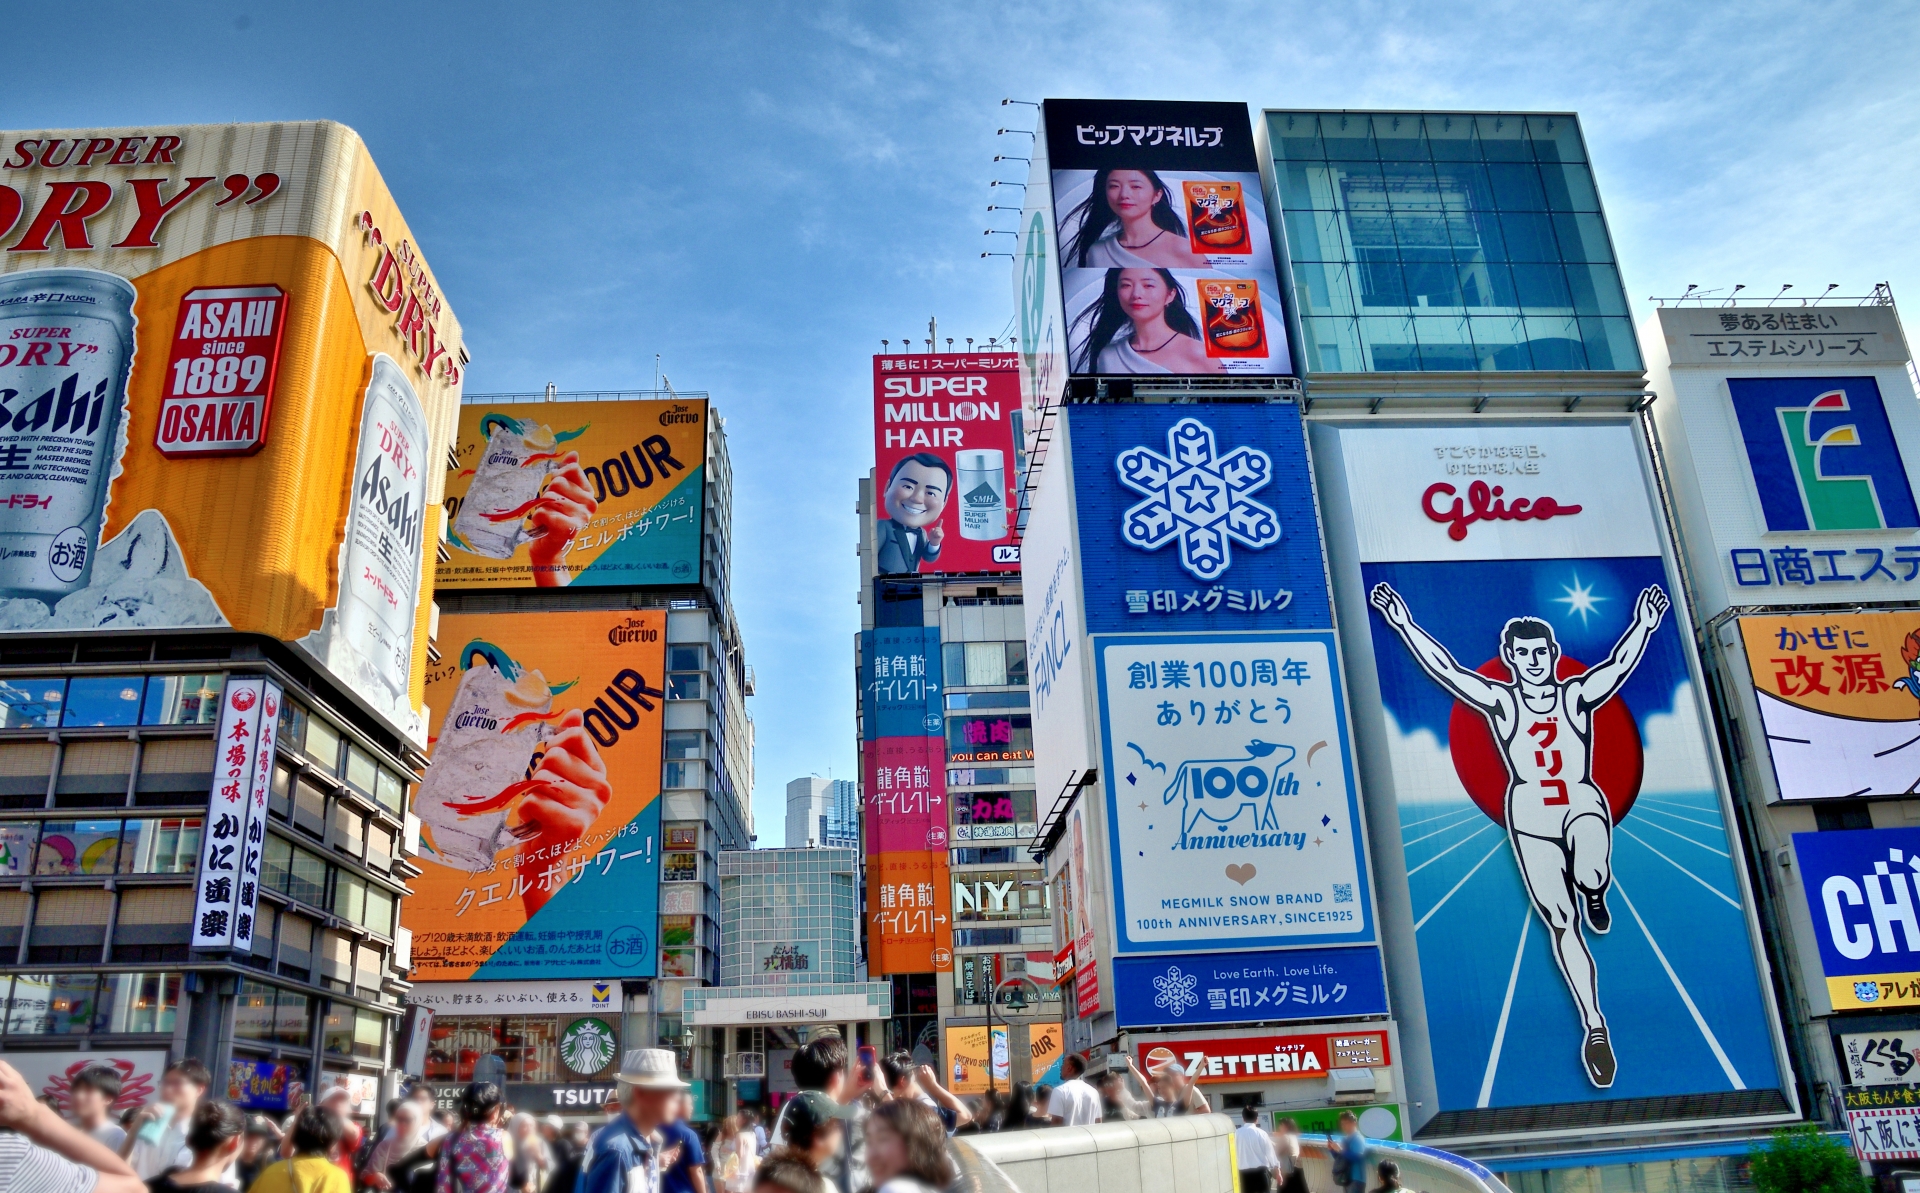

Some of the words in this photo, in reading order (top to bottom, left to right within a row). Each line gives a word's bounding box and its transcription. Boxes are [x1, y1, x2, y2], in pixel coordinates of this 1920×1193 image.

[1076, 125, 1224, 147] ピップマグネループ
[3, 135, 182, 170] SUPER
[0, 173, 281, 252] RY”
[1197, 198, 1233, 207] マグネループ
[401, 238, 442, 321] SUPER
[65, 294, 96, 303] KUCHI
[1211, 298, 1249, 307] マグネループ
[178, 300, 276, 341] ASAHI
[1718, 313, 1838, 331] 夢ある住まい
[9, 327, 72, 340] SUPER
[201, 340, 246, 355] since
[1706, 337, 1868, 357] エステムシリーズ
[171, 355, 268, 396] 1889
[884, 376, 988, 398] SUPER
[658, 410, 699, 426] Cuervo
[672, 404, 689, 414] Jose
[884, 401, 1000, 423] MILLION
[161, 402, 256, 443] OSAKA
[40, 435, 73, 444] PRECISION
[389, 420, 410, 453] SUPER
[885, 427, 964, 449] HAIR
[34, 454, 64, 462] MASTER
[36, 444, 61, 453] UNDER
[62, 446, 74, 454] THE
[488, 453, 518, 466] Cuervo
[48, 464, 89, 475] TECHNIQUES
[1446, 460, 1540, 476] ゆたかな人生
[360, 453, 418, 556] Asahi
[972, 494, 994, 503] SMH
[568, 496, 686, 535] ソーダで割って、ほどよくハジける
[51, 541, 87, 570] お酒
[378, 531, 393, 565] 生
[364, 566, 398, 610] スーパードライ
[1125, 585, 1293, 613] 雪印メグミルク
[625, 617, 645, 628] Jose
[608, 624, 657, 646] Cuervo
[1774, 624, 1869, 651] かぜに
[874, 654, 928, 679] 龍角散
[1035, 600, 1071, 720] FANCL
[1127, 657, 1311, 690] 創業100周年
[1770, 652, 1890, 697] 改源
[455, 710, 497, 730] Cuervo
[472, 704, 490, 715] Jose
[583, 668, 664, 752] OUR
[1156, 697, 1292, 726] ありがとう
[923, 718, 941, 727] 生薬
[962, 719, 1013, 744] 焼肉
[220, 718, 250, 803] 本場の味
[254, 723, 273, 809] 本場の味
[951, 750, 973, 762] you
[976, 750, 999, 761] can
[1002, 749, 1022, 761] eat
[1526, 716, 1570, 806] グリコ
[877, 765, 931, 790] 龍角散
[972, 797, 1014, 819] 力丸
[928, 831, 945, 840] 生薬
[1171, 830, 1306, 850] Anniversary
[467, 821, 639, 880] ソーダで割って、ほどよくハジける
[880, 883, 935, 908] 龍角散
[1161, 896, 1224, 910] MEGMILK
[1230, 894, 1270, 907] SNOW
[1276, 893, 1323, 905] BRAND
[1136, 917, 1173, 930] 100th
[609, 937, 643, 955] お酒
[772, 945, 799, 955] なんば
[763, 954, 809, 971] 戎橋筋
[933, 953, 949, 962] 生薬
[964, 961, 975, 999] 焼きそば
[1213, 969, 1240, 980] Love
[1243, 967, 1279, 979] Earth.
[1283, 966, 1310, 977] Love
[1313, 964, 1338, 976] Life.
[1207, 982, 1349, 1010] 雪印メグミルク
[746, 1010, 774, 1019] EBISU
[1031, 1035, 1056, 1059] OUR
[1335, 1038, 1377, 1047] 絶品バーガー
[1336, 1049, 1370, 1057] フェアトレード
[1184, 1051, 1322, 1077] ZETTERIA
[1351, 1056, 1379, 1064] コーヒー
[1861, 1037, 1915, 1076] くくる
[435, 1099, 453, 1109] EE
